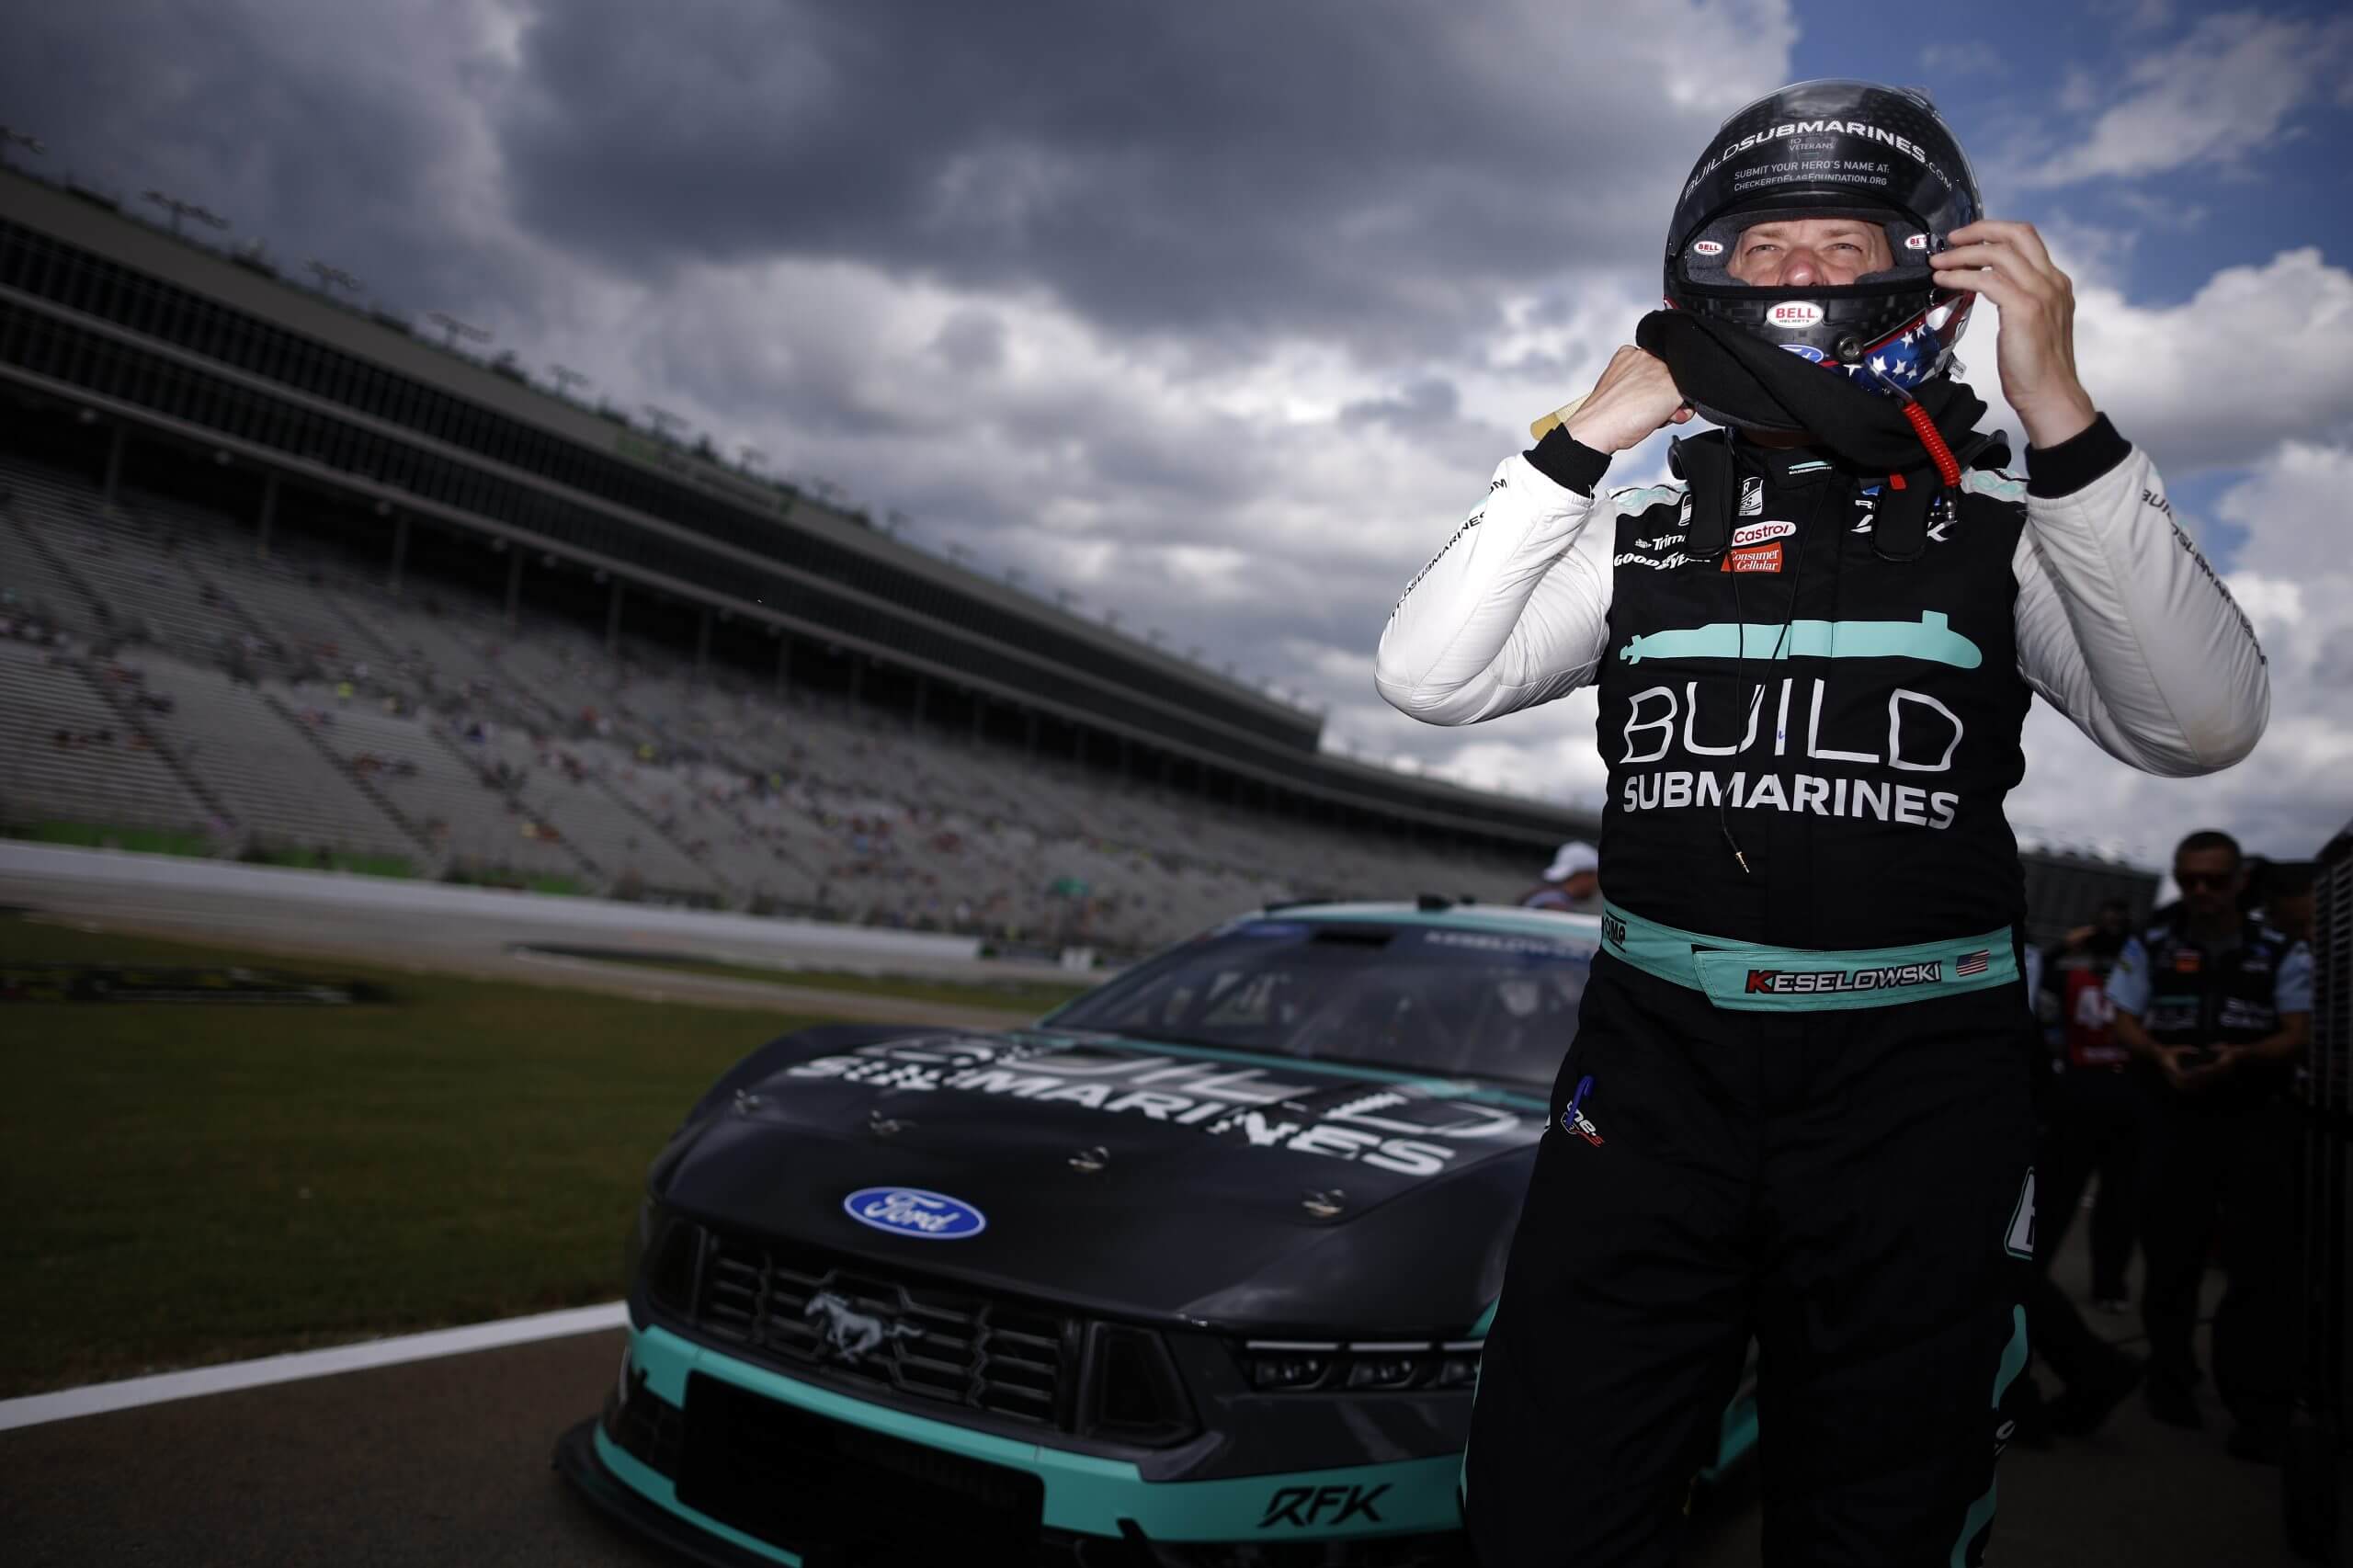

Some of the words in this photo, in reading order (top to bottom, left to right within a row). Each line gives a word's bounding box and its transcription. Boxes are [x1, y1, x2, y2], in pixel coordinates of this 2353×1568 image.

[1734, 165, 1769, 180] SUBMIT
[1771, 161, 1798, 173] YOUR
[1801, 160, 1841, 171] HERO'S
[1843, 161, 1875, 172] NAME
[1775, 308, 1816, 319] BELL
[1733, 524, 1790, 544] Castrol
[1731, 548, 1779, 561] Consumer
[1736, 559, 1779, 572] Cellular
[1620, 677, 1963, 772] BUILD
[1623, 770, 1959, 830] SUBMARINES
[1747, 960, 1942, 994] KESELOWSKI
[1256, 1482, 1394, 1528] RFK
